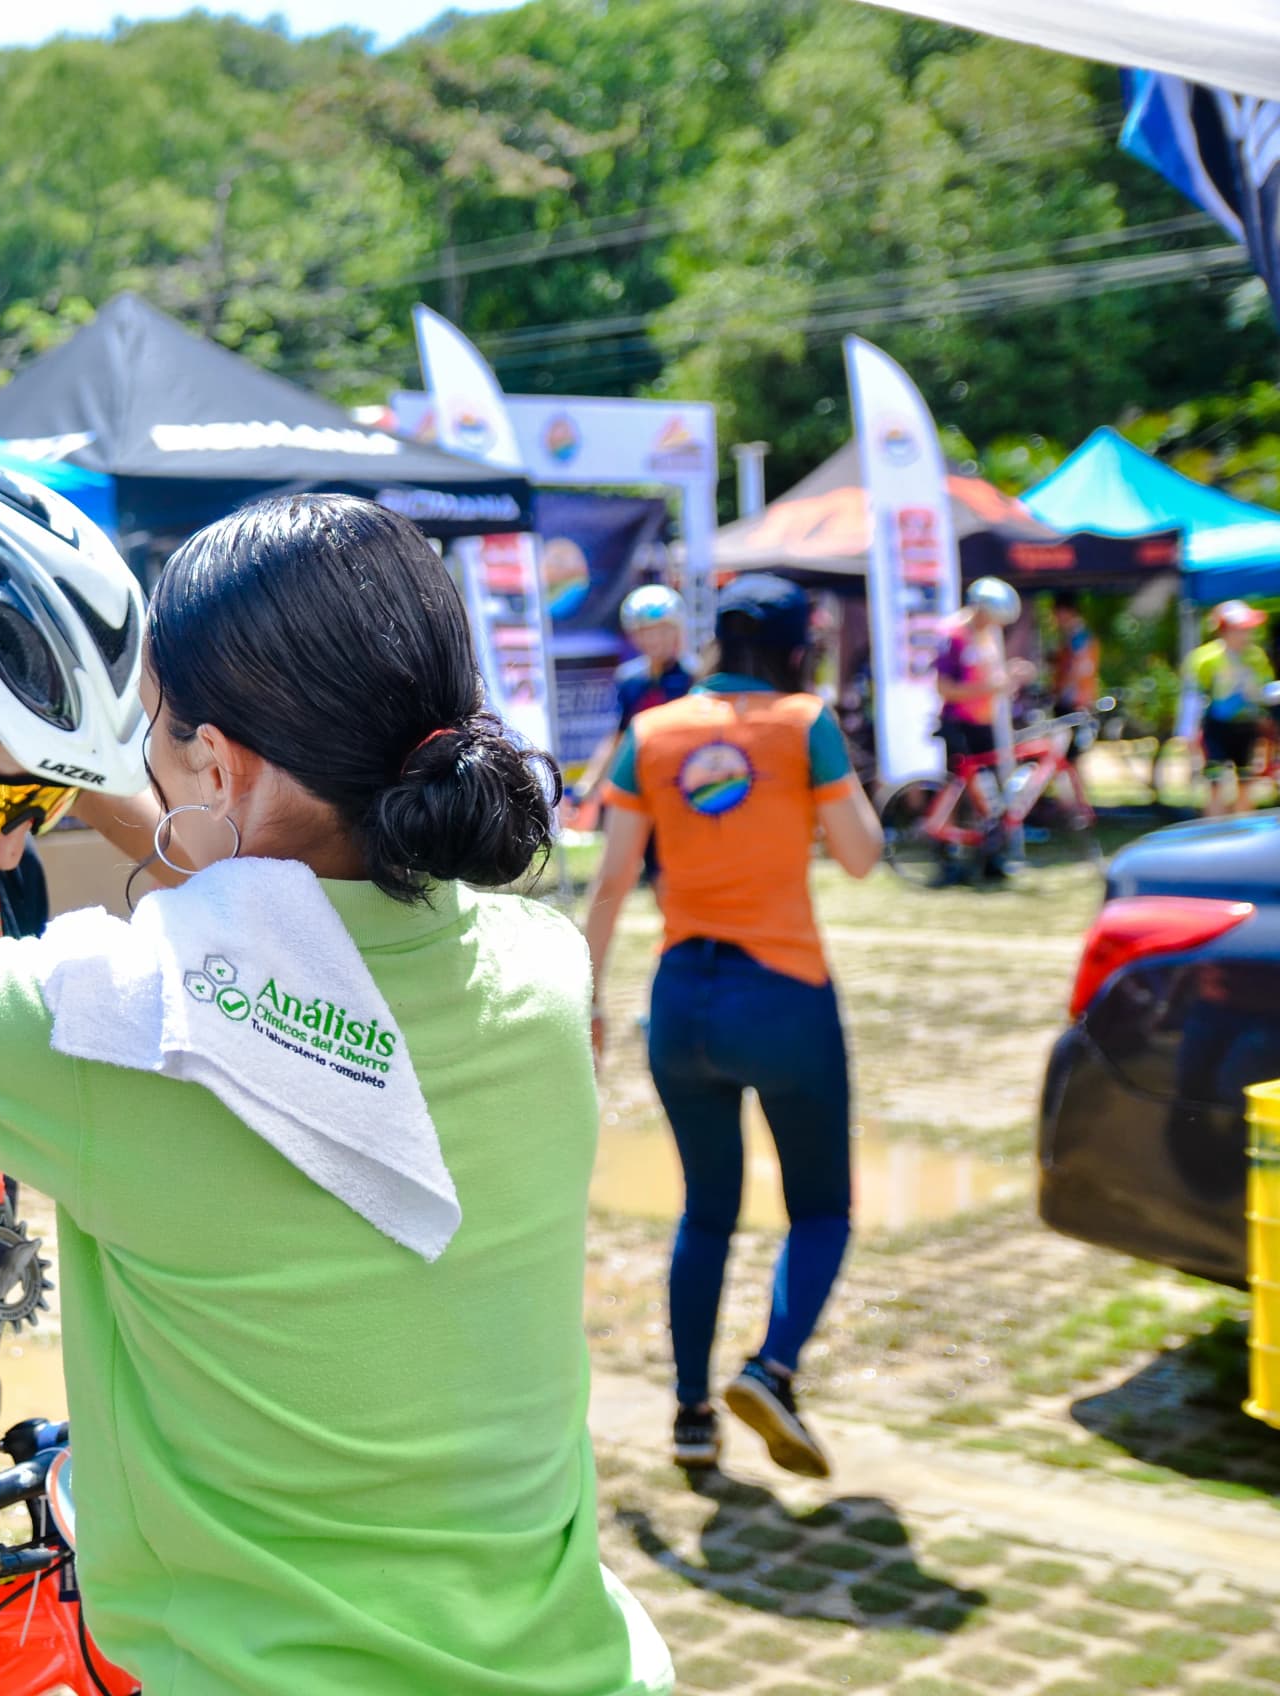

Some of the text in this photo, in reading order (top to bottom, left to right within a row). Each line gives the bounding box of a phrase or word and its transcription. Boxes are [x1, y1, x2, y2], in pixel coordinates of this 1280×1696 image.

[37, 759, 107, 786] LAZER
[257, 977, 397, 1058] Análisis
[252, 1018, 386, 1089] Tu laboratorio completo
[310, 1034, 334, 1054] del
[335, 1045, 390, 1074] Ahorro
